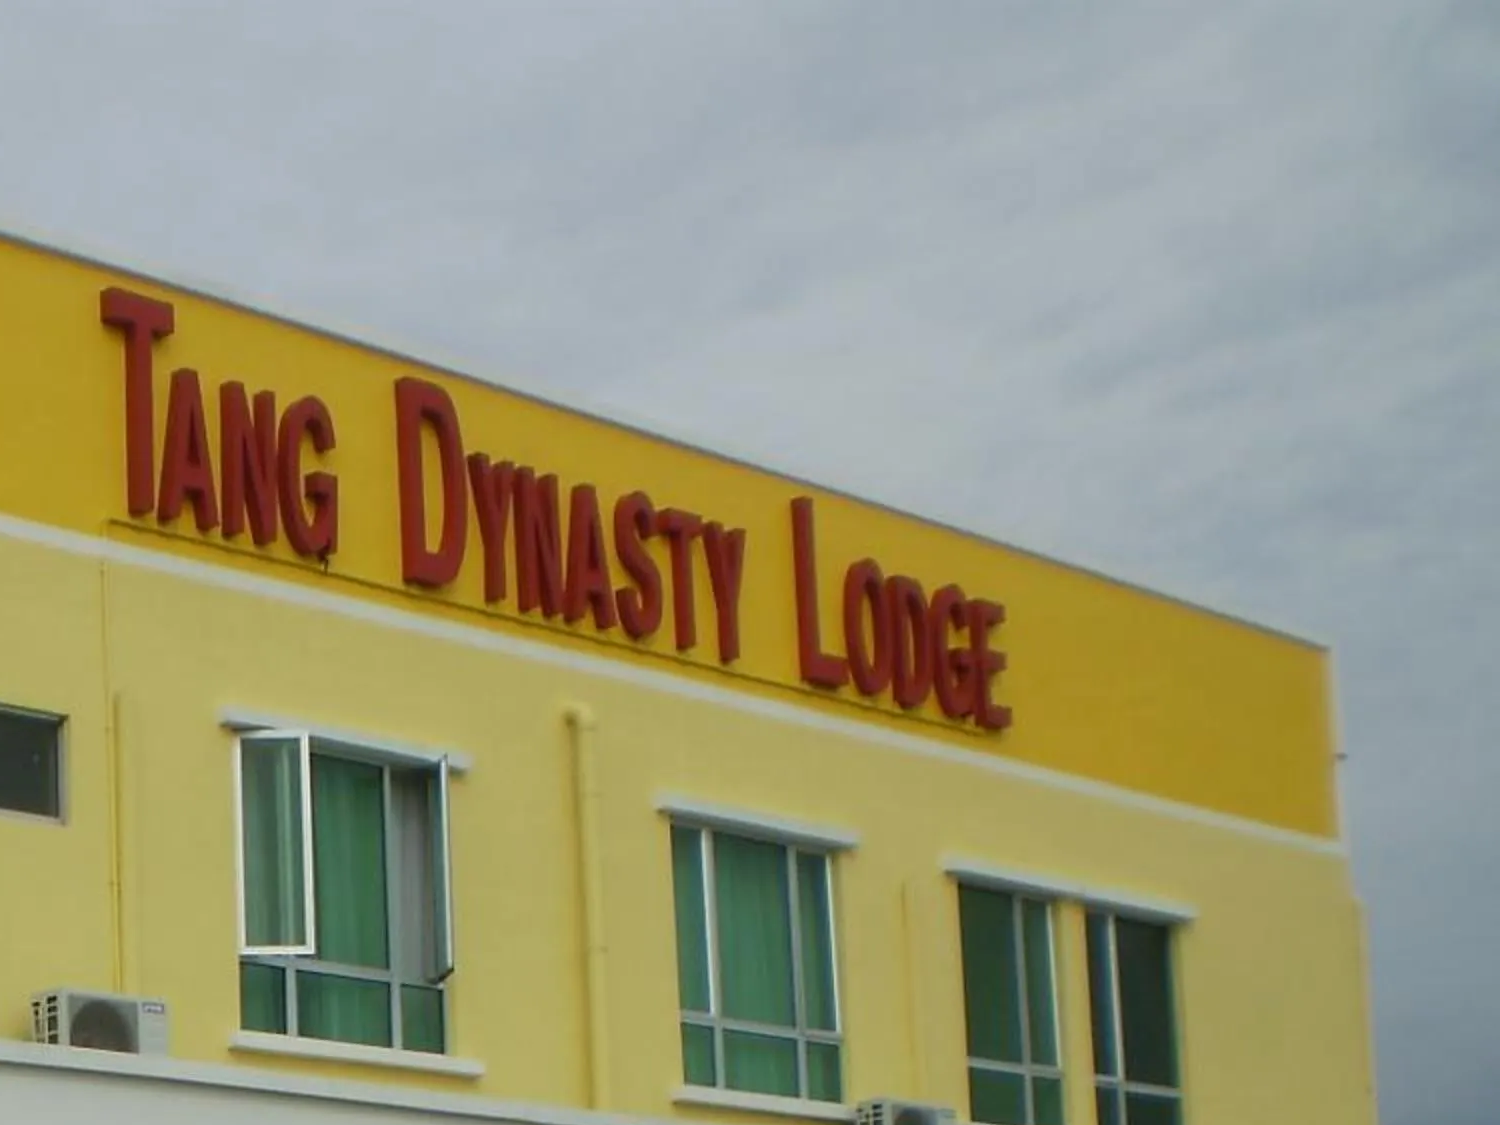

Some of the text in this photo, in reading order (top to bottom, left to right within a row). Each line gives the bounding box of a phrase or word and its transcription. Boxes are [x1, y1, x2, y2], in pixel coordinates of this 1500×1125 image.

[100, 287, 1013, 732] TANG DYNASTY LODGE
